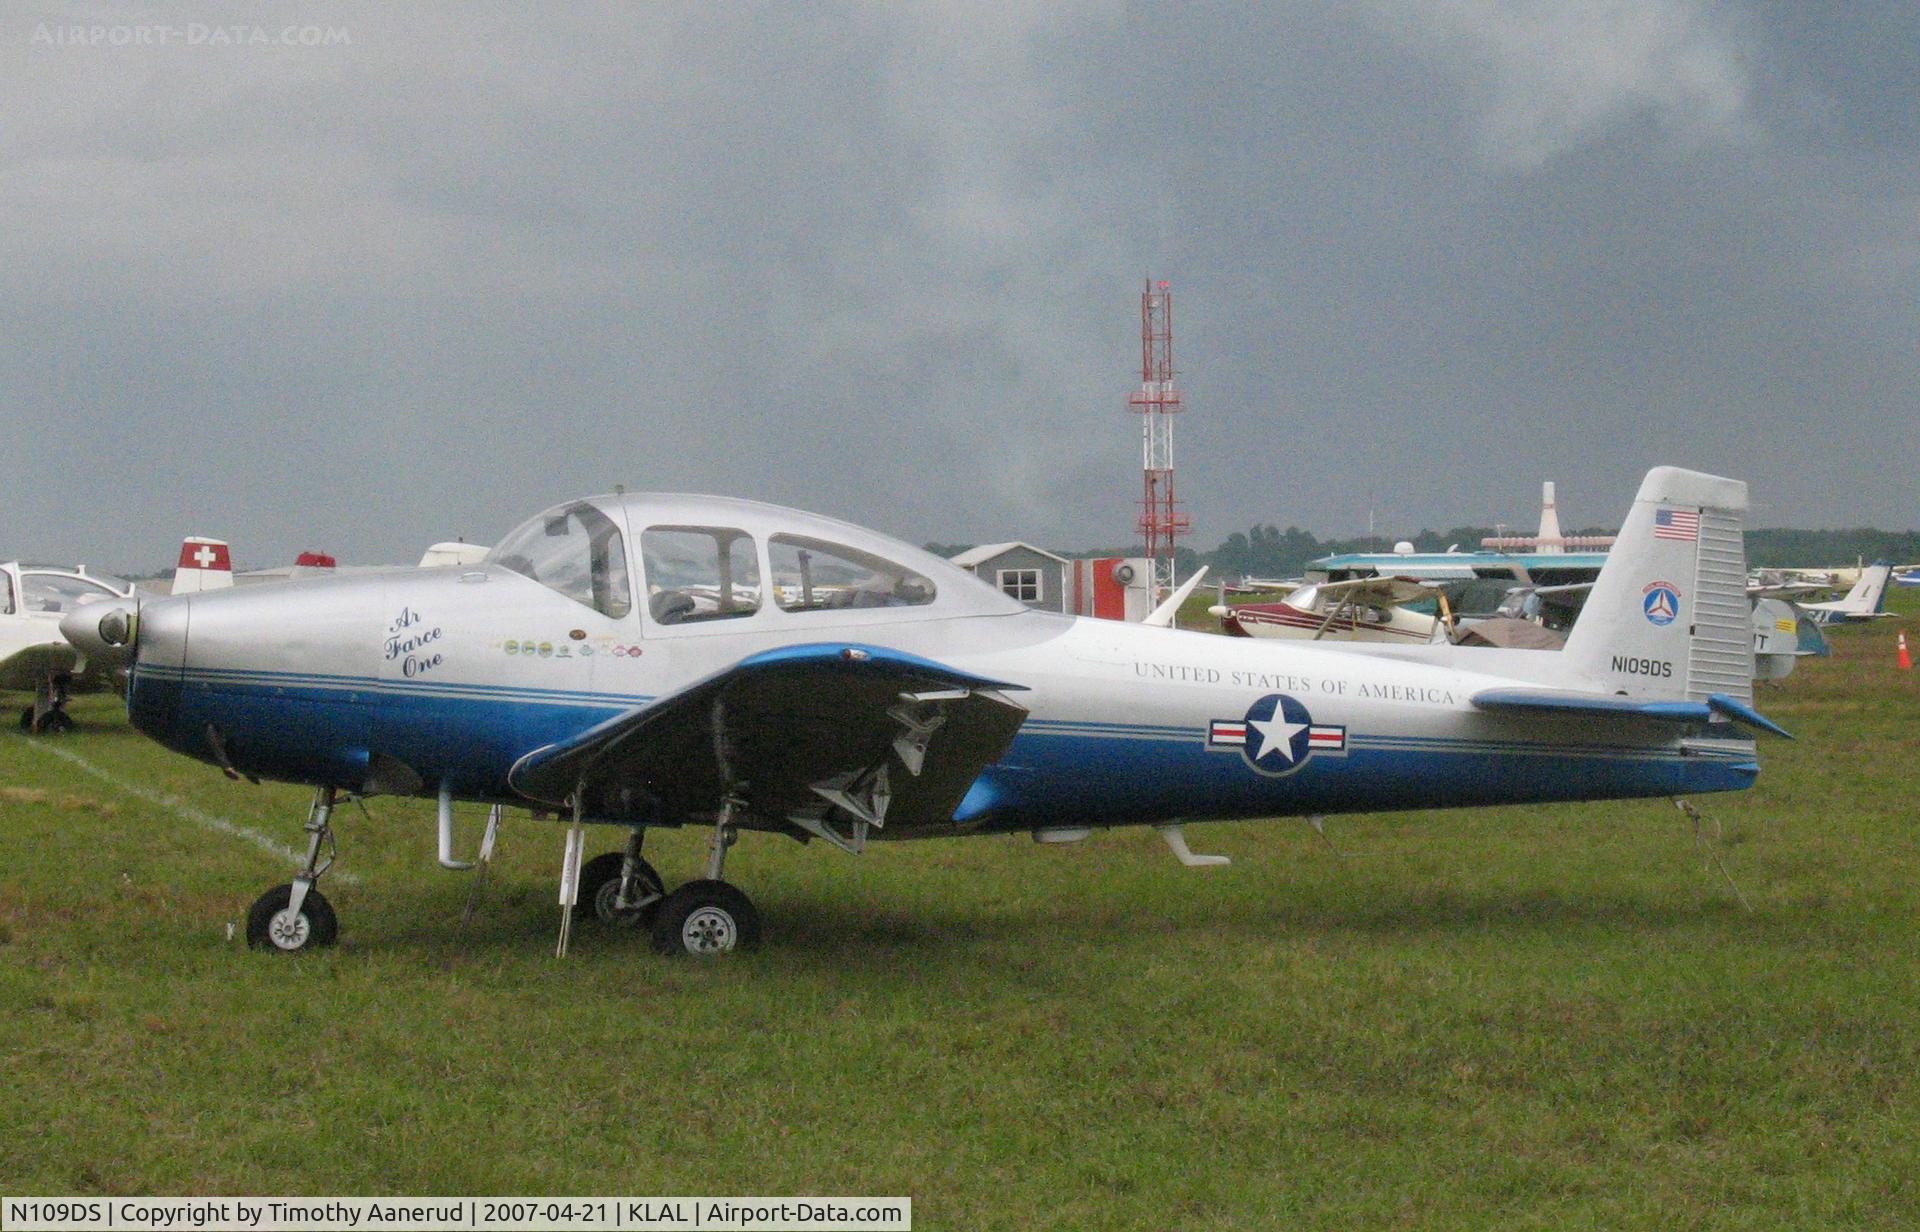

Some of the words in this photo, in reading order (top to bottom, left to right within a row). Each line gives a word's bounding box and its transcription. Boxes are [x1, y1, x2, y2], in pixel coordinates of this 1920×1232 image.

[384, 627, 442, 660] Farce
[402, 653, 442, 678] One
[1611, 655, 1673, 678] N109DS
[1135, 661, 1221, 684] UNITED
[1231, 671, 1311, 692] STATES
[1321, 679, 1348, 695] OF
[1358, 683, 1455, 705] AMERICA
